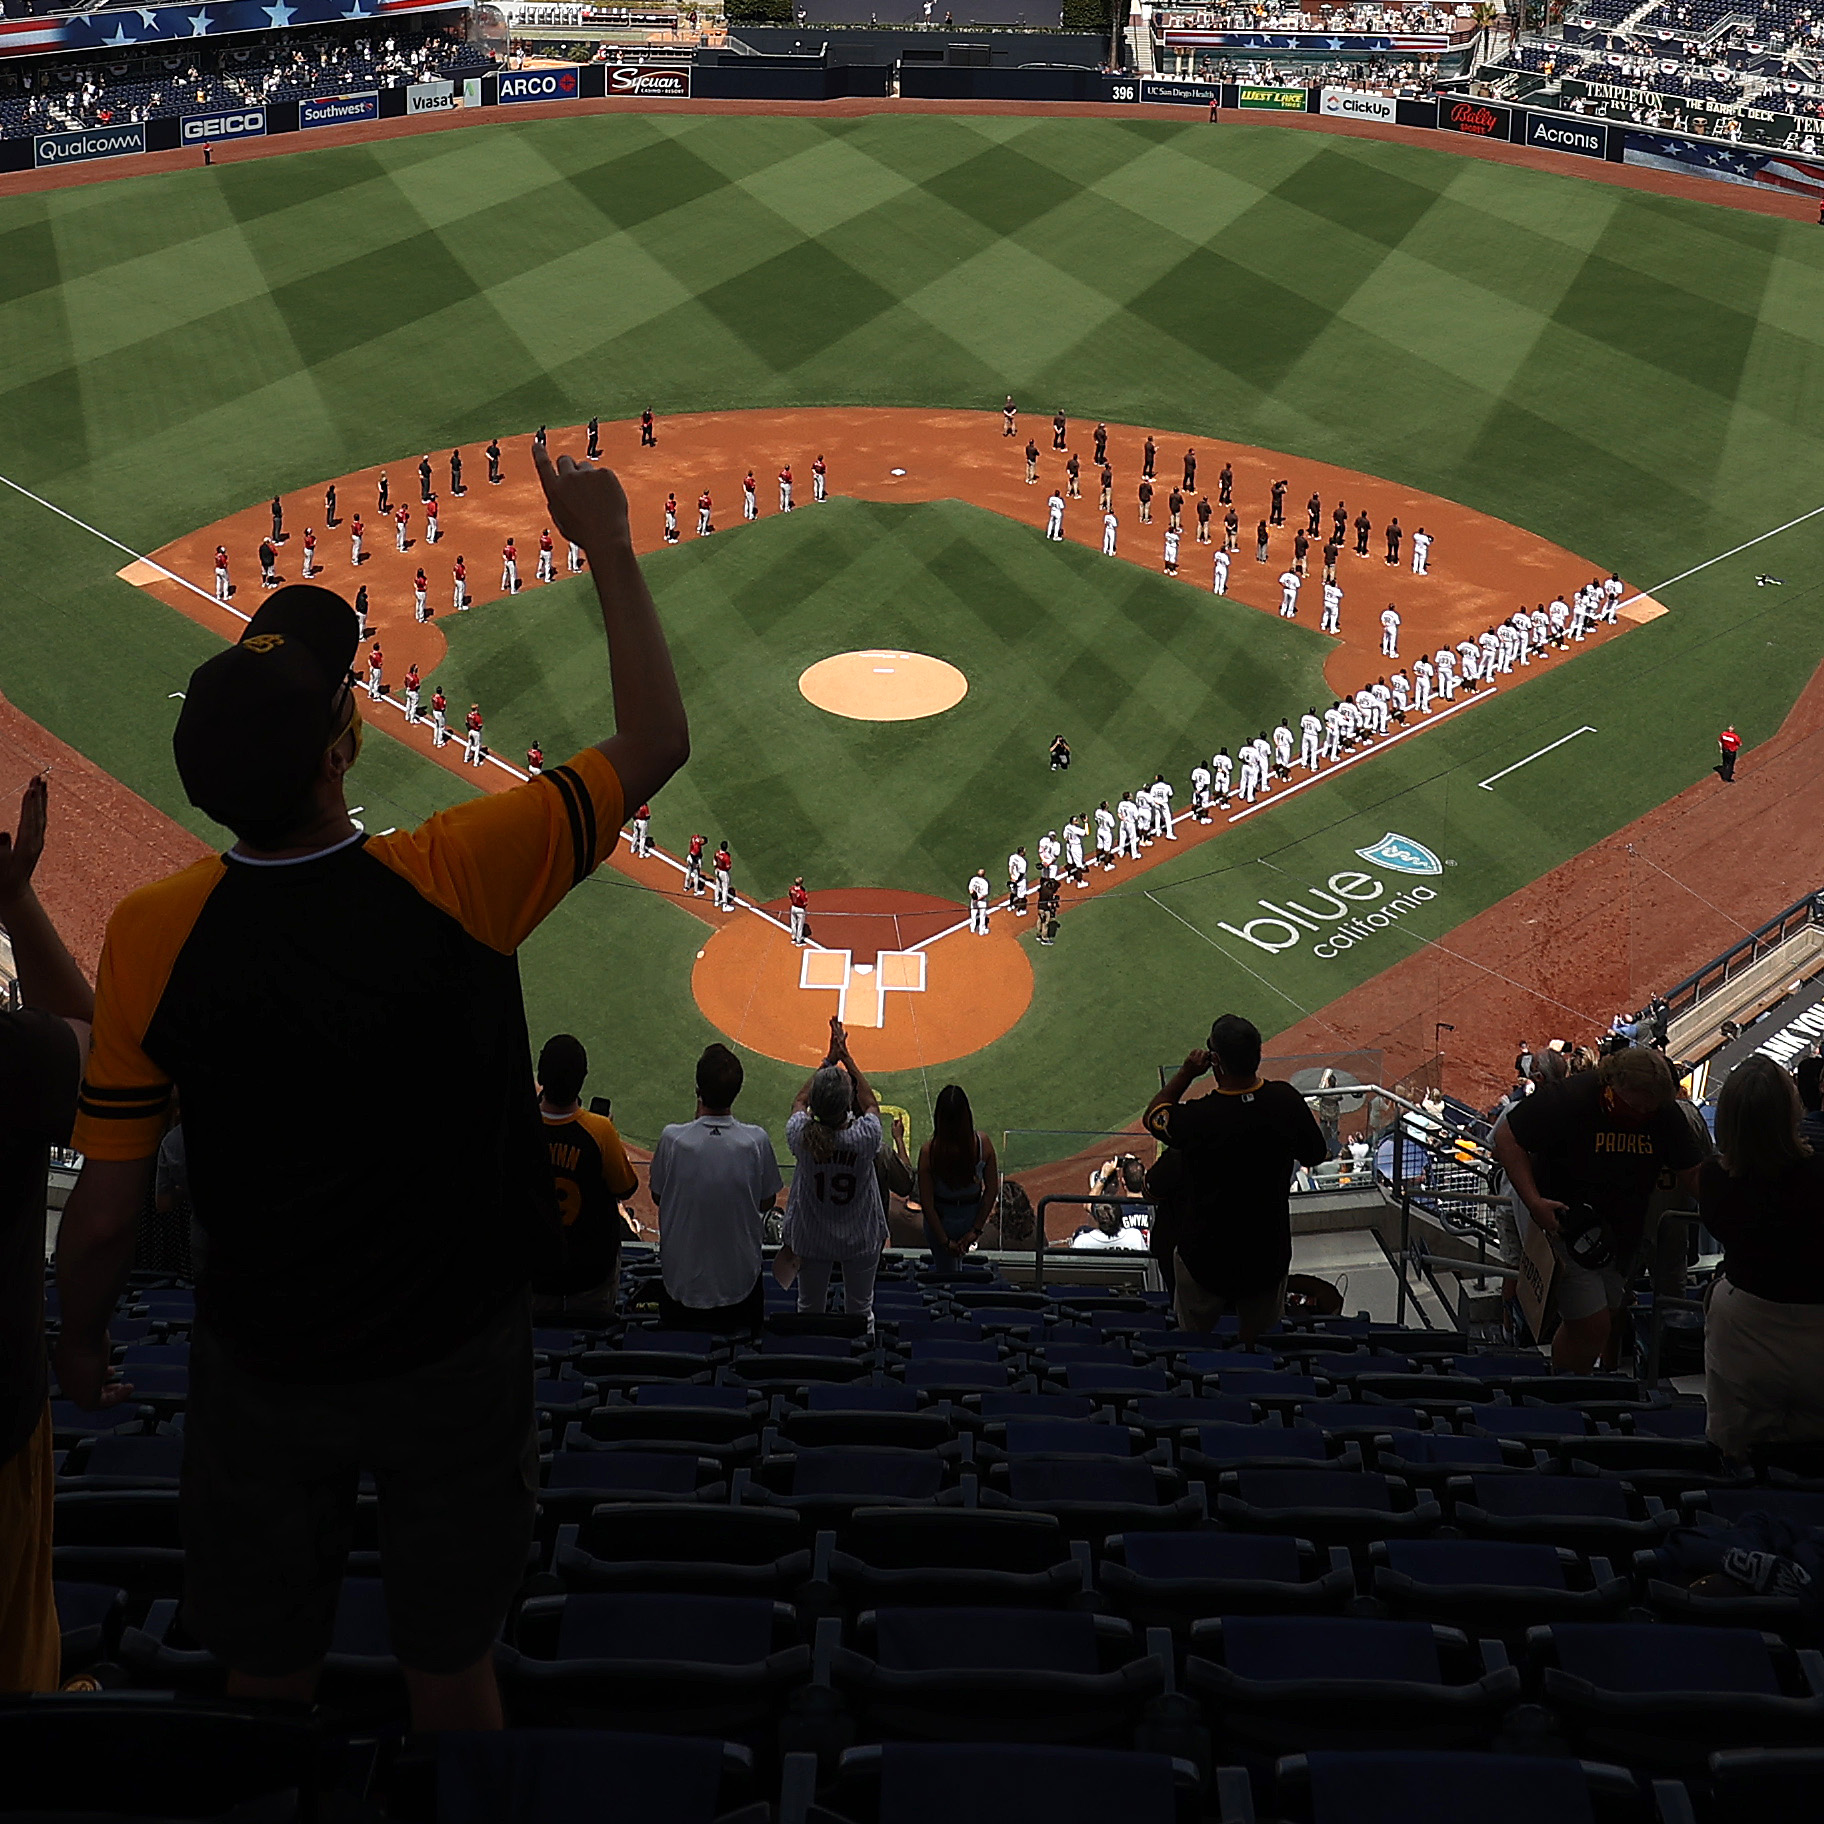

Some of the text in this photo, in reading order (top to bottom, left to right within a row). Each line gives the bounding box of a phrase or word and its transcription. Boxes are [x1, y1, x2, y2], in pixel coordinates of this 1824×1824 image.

[501, 76, 556, 97] ARCO
[612, 68, 681, 94] Sycuan
[1112, 86, 1133, 100] 396
[1147, 86, 1215, 99] UC San Diego Health
[412, 92, 454, 110] Viasat
[1241, 90, 1304, 102] WEST LAKE
[1342, 99, 1391, 117] ClickUp
[1585, 83, 1663, 112] TEMPLETON
[305, 102, 365, 121] Southwest
[1451, 103, 1497, 132] Bally
[1685, 99, 1703, 110] THE
[1747, 108, 1775, 123] DECK
[184, 112, 264, 139] GEICO
[1533, 123, 1599, 150] Acronis
[39, 133, 142, 160] Qualcomm
[1217, 870, 1384, 954] blue
[1313, 884, 1439, 959] california
[1594, 1131, 1655, 1155] PADRES
[814, 1172, 857, 1206] 19
